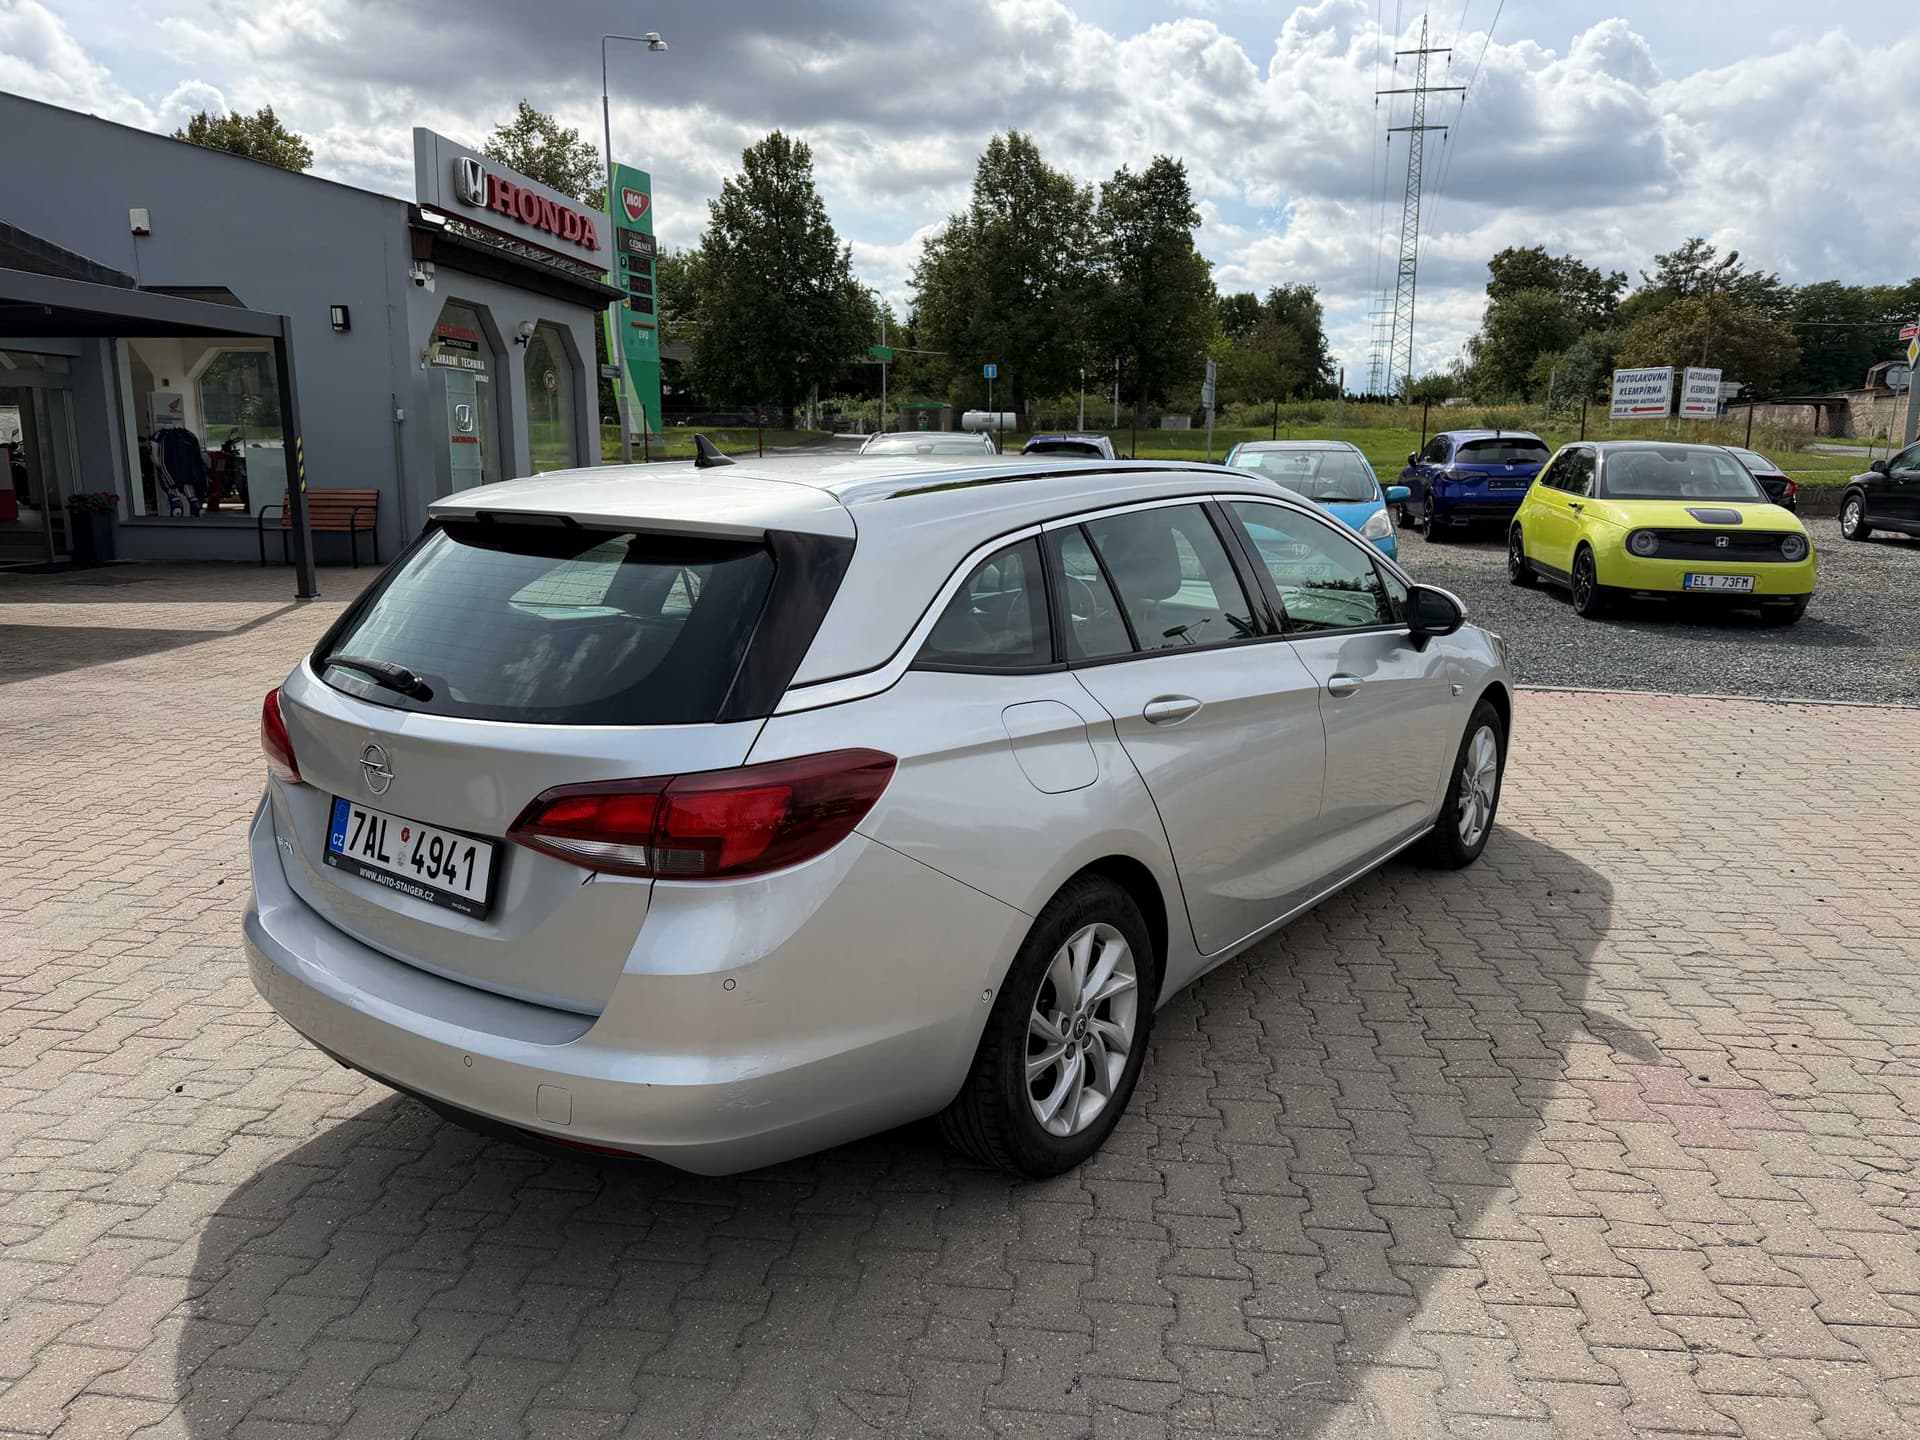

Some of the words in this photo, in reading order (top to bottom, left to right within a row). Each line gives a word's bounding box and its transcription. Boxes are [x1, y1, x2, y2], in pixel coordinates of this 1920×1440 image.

[627, 192, 642, 208] MOL
[487, 174, 601, 250] HONDA
[461, 357, 485, 370] TECHNIKA
[1616, 372, 1668, 383] AUTOLAKOVNA
[1619, 384, 1662, 396] KLEMPÍRNA
[1693, 575, 1714, 587] EL1
[1721, 576, 1749, 588] 73FM
[332, 832, 344, 847] CZ
[348, 811, 391, 864] 7AL
[410, 831, 476, 892] 4941
[359, 867, 434, 902] WWW.AUTO-STAIGER.CZ
